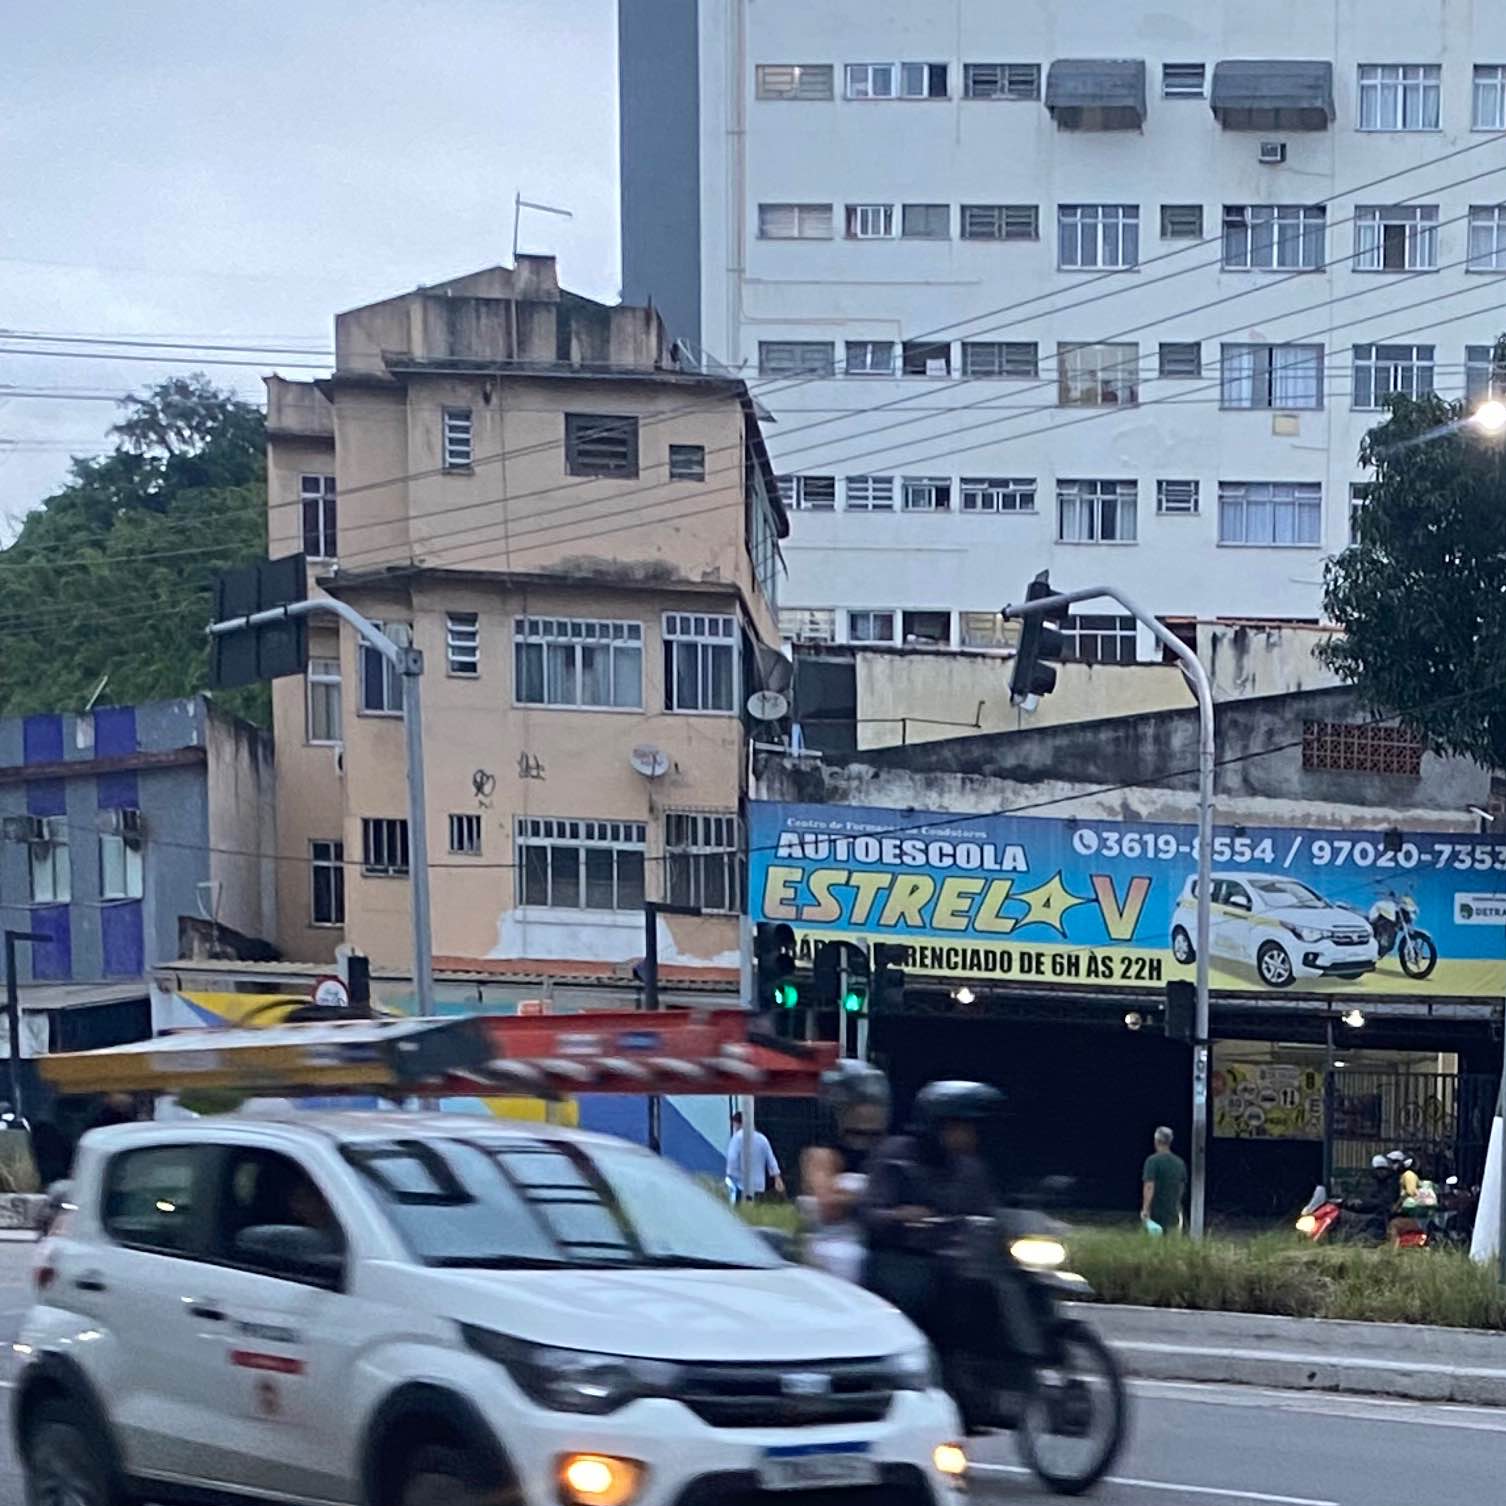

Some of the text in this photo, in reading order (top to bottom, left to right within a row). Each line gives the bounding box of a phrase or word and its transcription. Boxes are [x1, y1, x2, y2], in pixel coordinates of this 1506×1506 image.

[775, 831, 1030, 872] AUTOESCOLA
[1090, 873, 1153, 942] V
[1019, 951, 1045, 975] DE
[1051, 953, 1080, 977] 6H
[1086, 950, 1114, 979] ÀS
[1119, 956, 1162, 980] 22H
